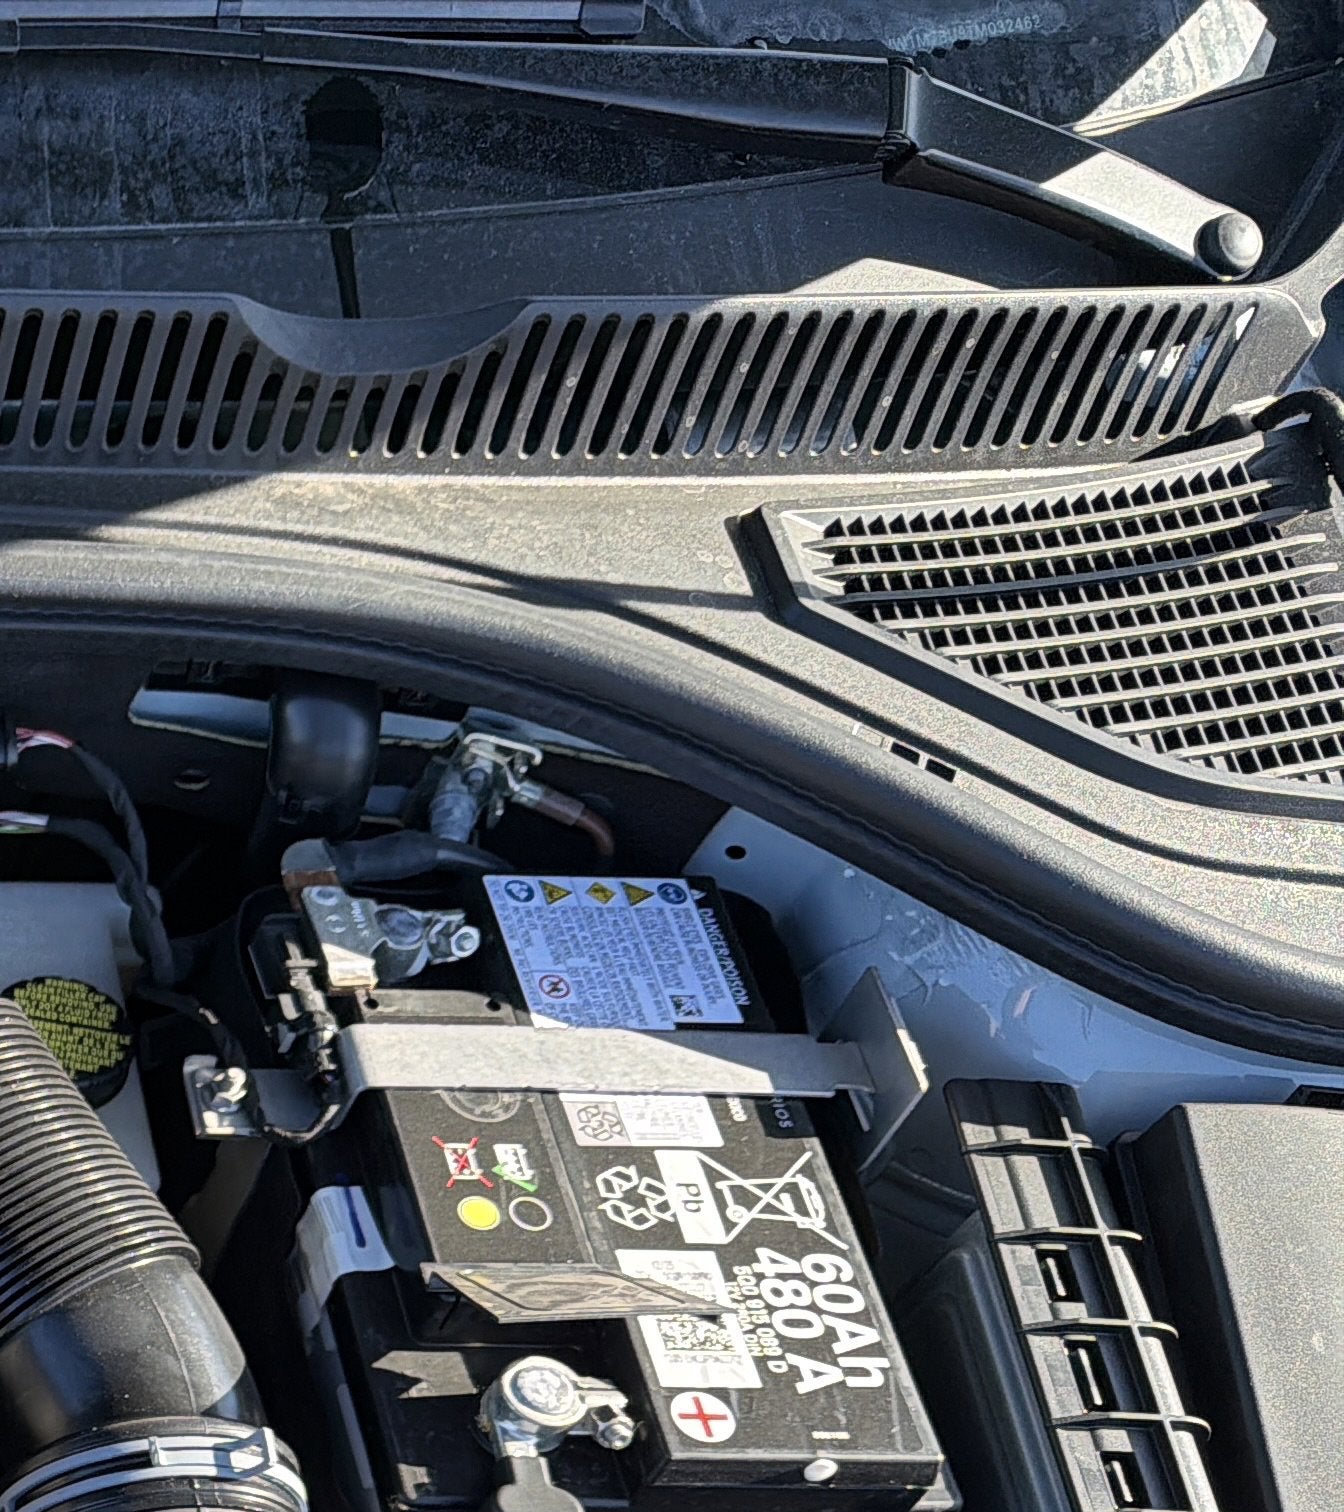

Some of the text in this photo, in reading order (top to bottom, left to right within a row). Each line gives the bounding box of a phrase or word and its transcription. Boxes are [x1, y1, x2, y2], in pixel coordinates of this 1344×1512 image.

[700, 907, 751, 1007] DANGER/POISON
[676, 1183, 701, 1211] Pb
[751, 1247, 825, 1339] 480
[801, 1253, 890, 1388] 60Ah
[768, 1360, 789, 1374] D
[785, 1353, 846, 1395] A
